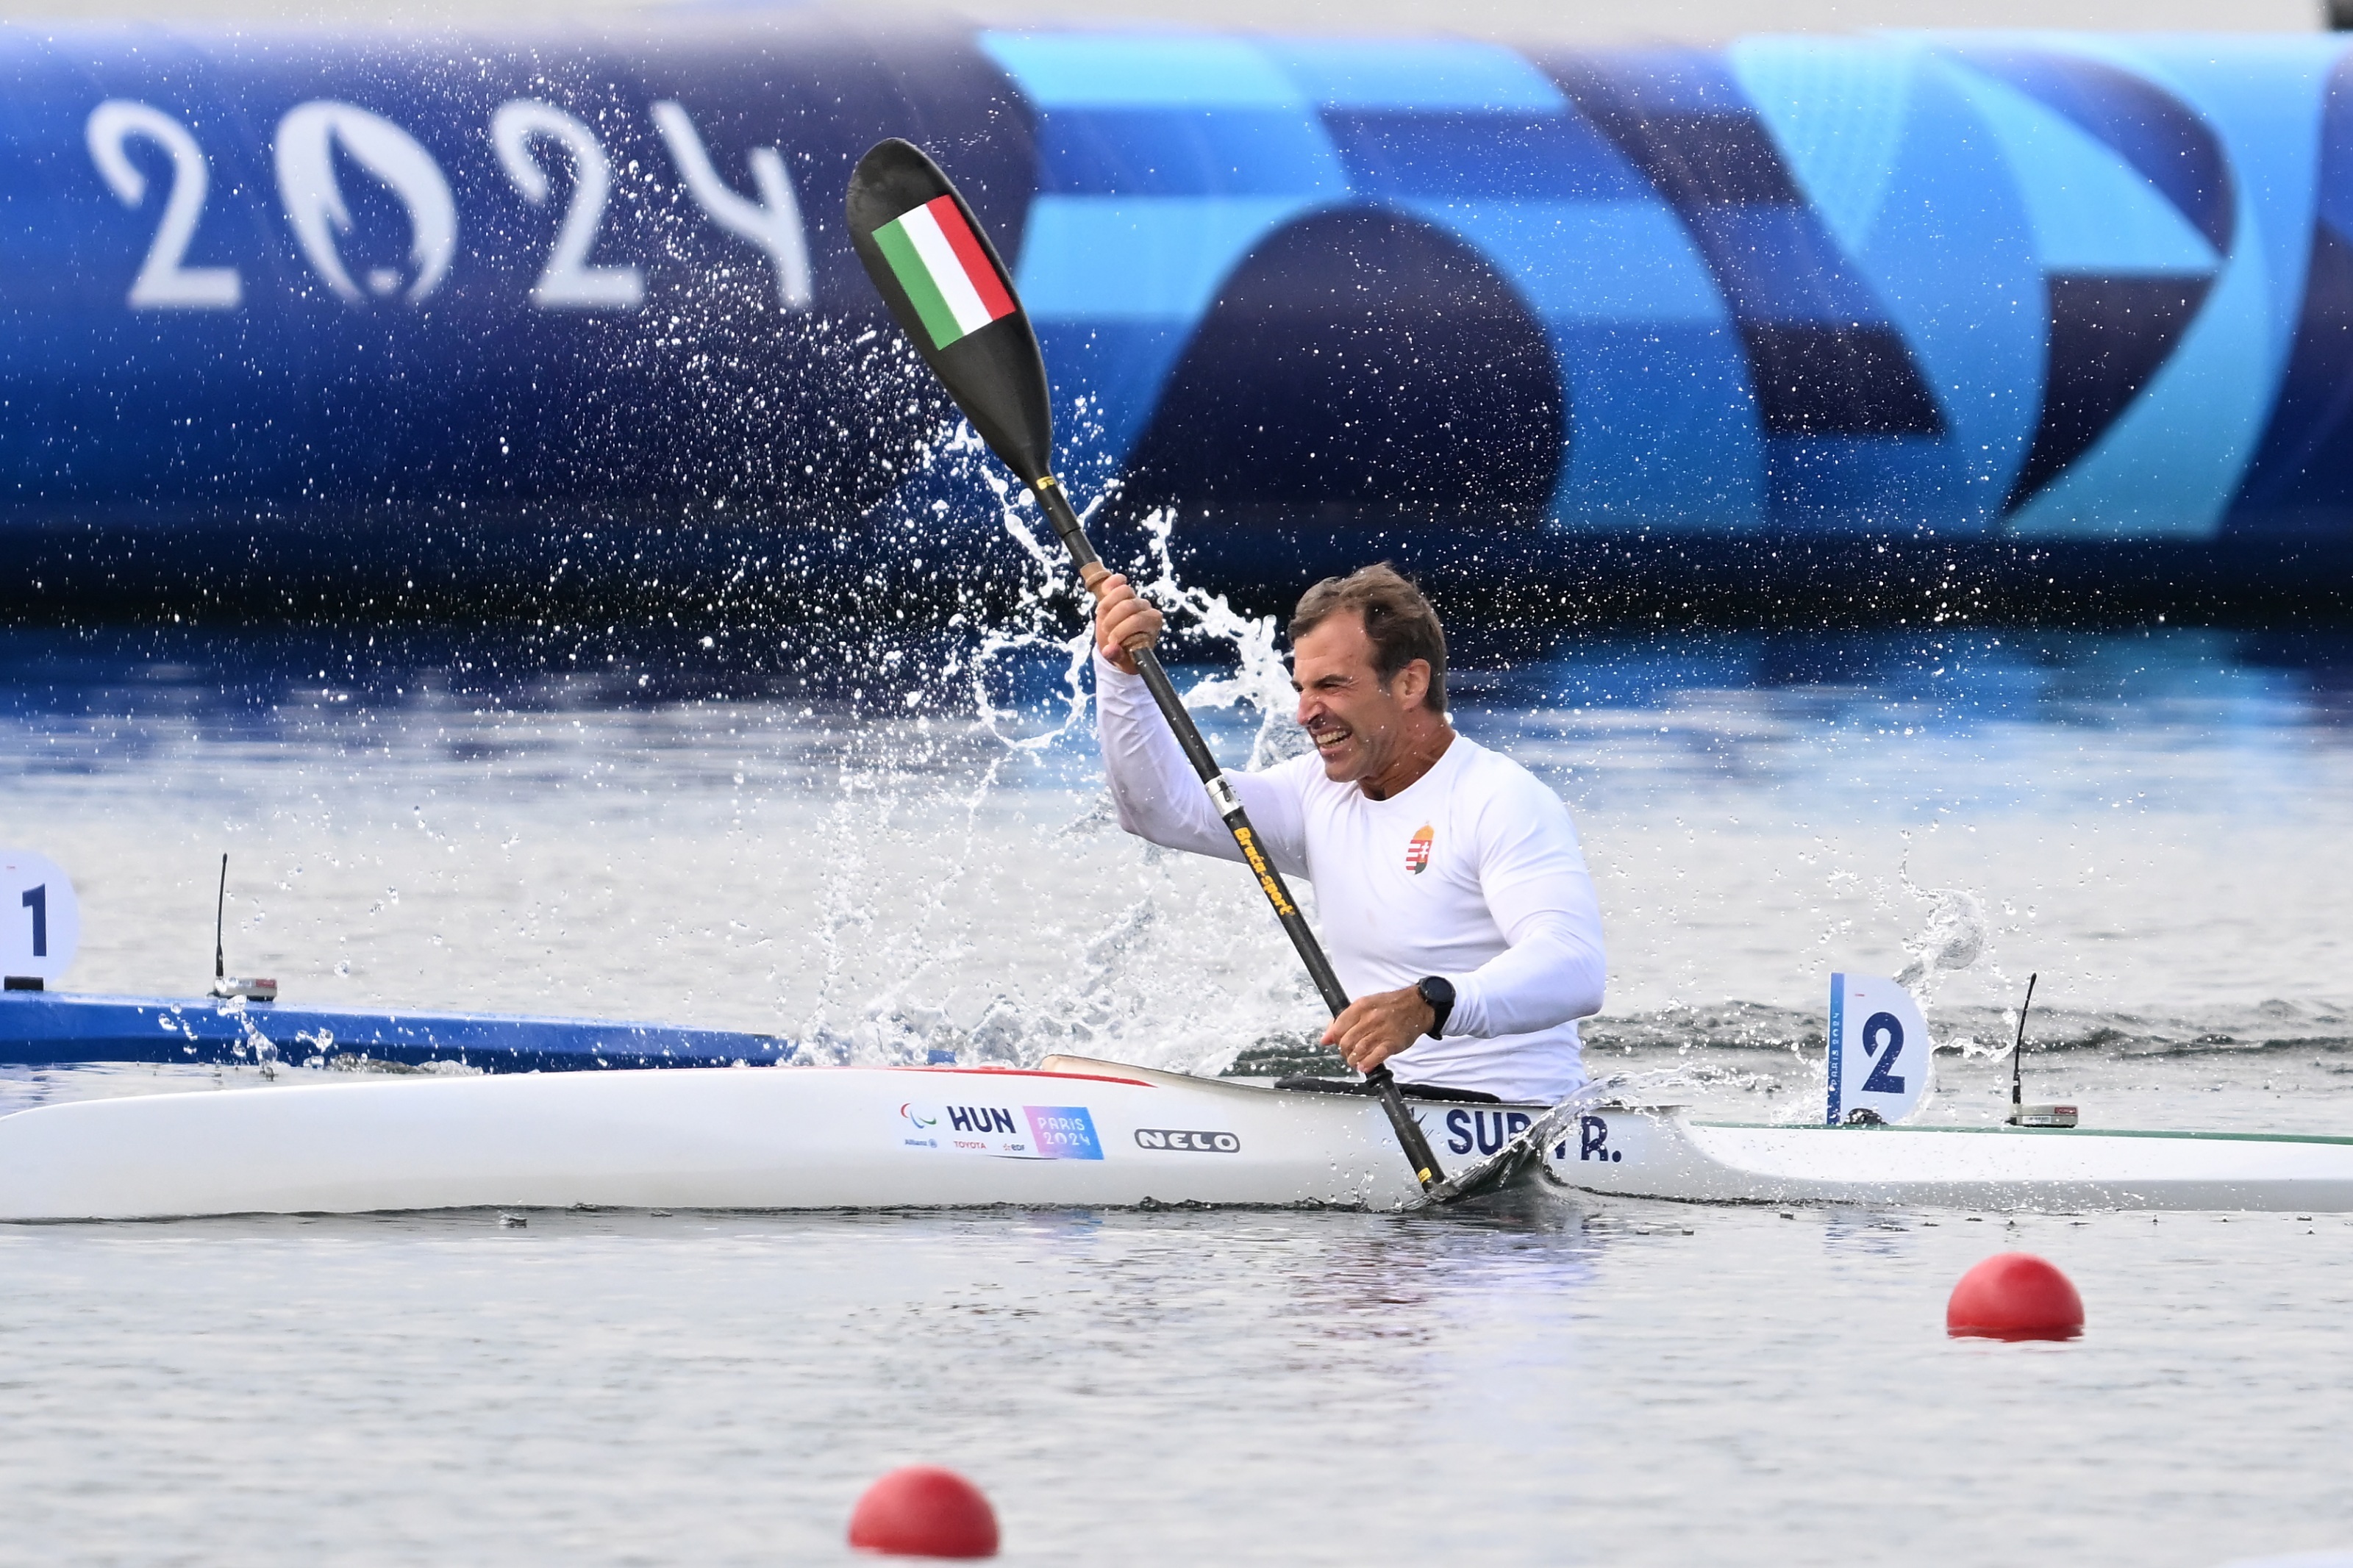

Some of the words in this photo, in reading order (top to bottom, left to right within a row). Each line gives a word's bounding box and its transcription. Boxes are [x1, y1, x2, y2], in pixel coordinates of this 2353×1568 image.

[85, 99, 813, 309] 2024
[22, 884, 46, 956] 1
[1862, 1012, 1905, 1094] 2
[946, 1106, 1016, 1134] HUN
[954, 1141, 986, 1149] TOYOTA
[1043, 1132, 1090, 1146] 2024
[1140, 1132, 1237, 1150] NELO
[1581, 1116, 1622, 1163] R.
